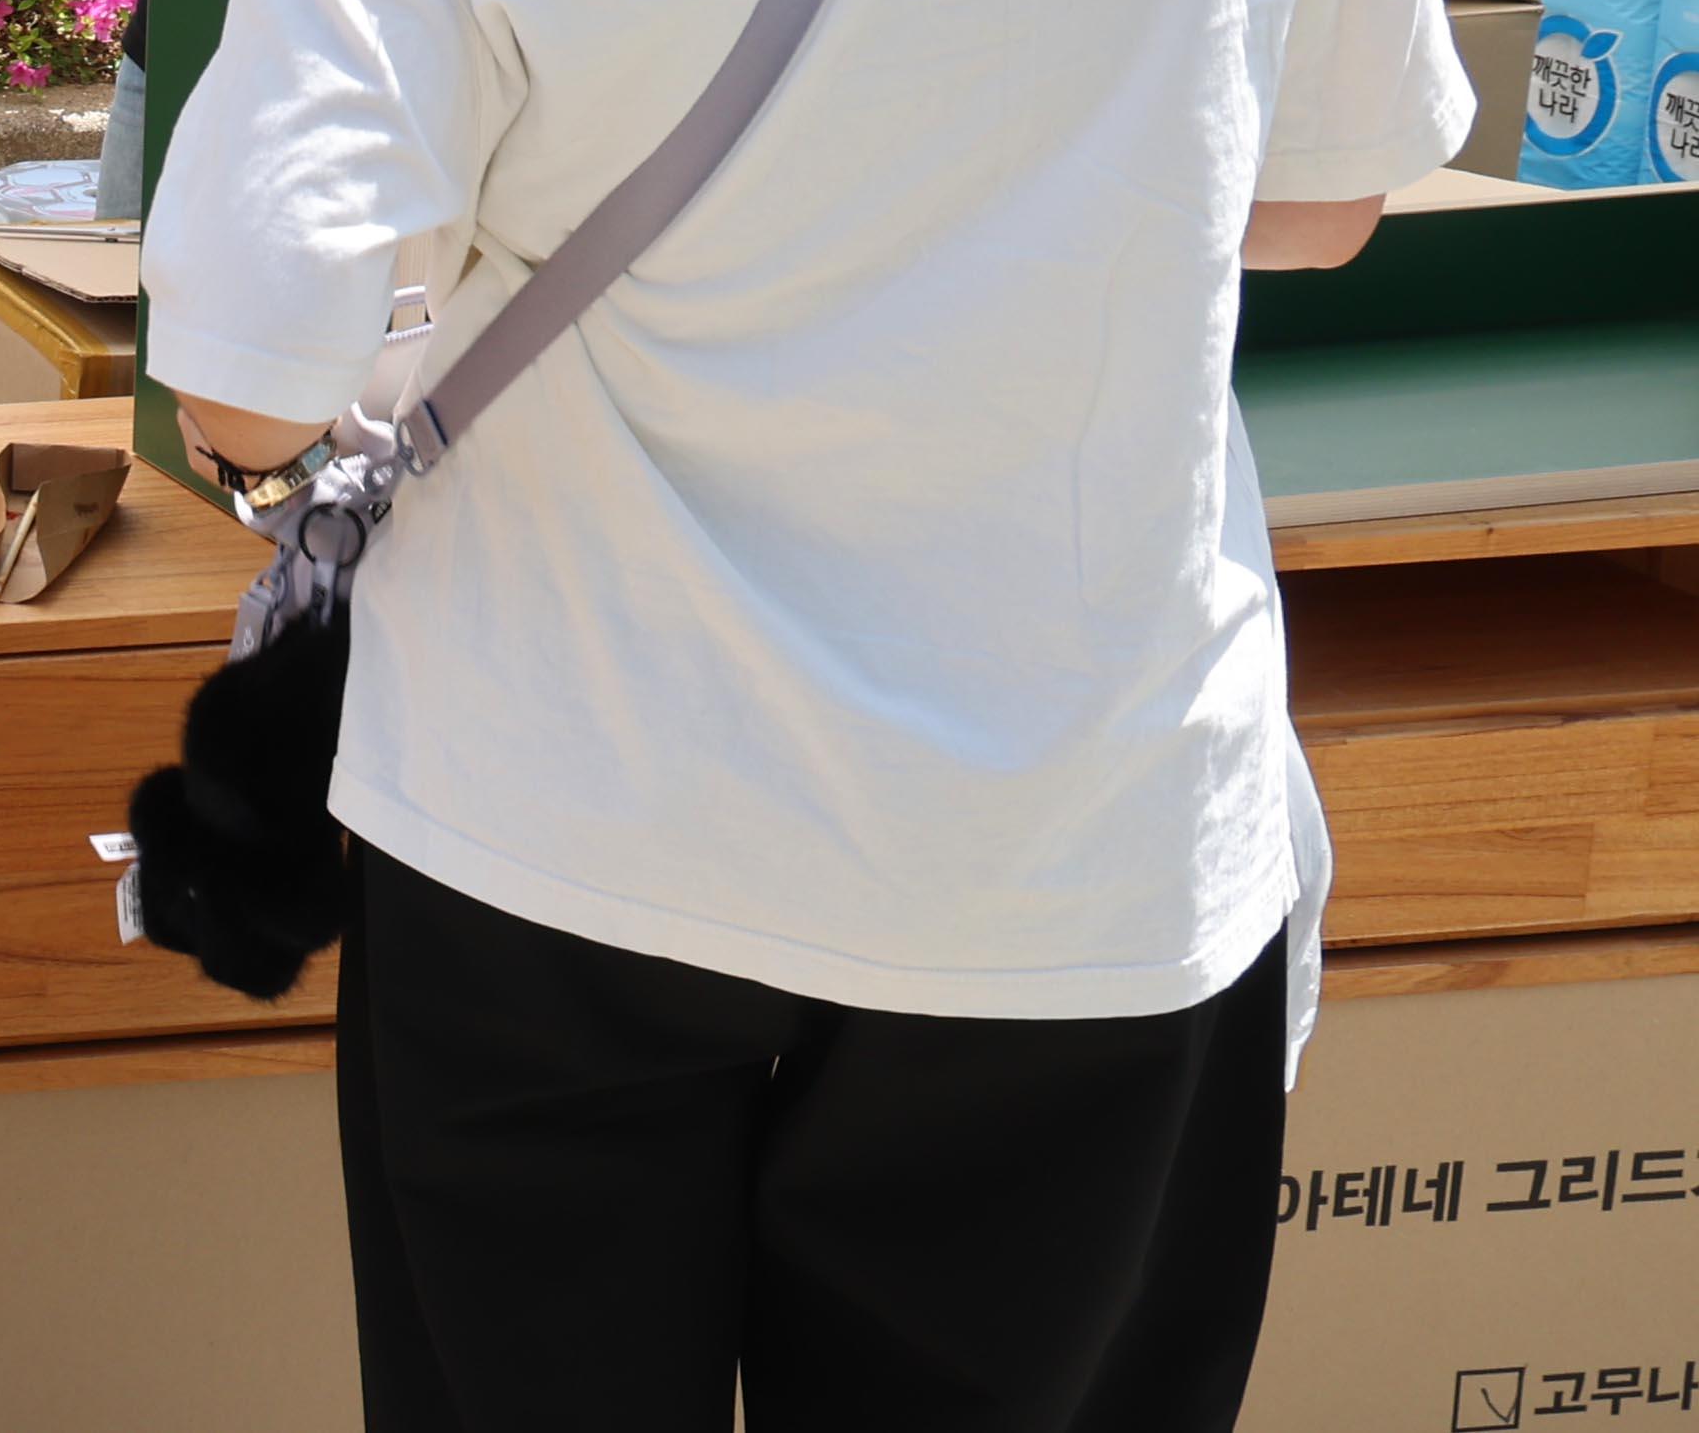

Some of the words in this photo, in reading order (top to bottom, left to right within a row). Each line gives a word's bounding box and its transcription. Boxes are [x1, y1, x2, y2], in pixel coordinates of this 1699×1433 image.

[1532, 54, 1592, 98] 깨끗한
[1538, 88, 1579, 124] 나라
[1277, 1160, 1465, 1231] 아테네
[1486, 1149, 1699, 1212] 그리드
